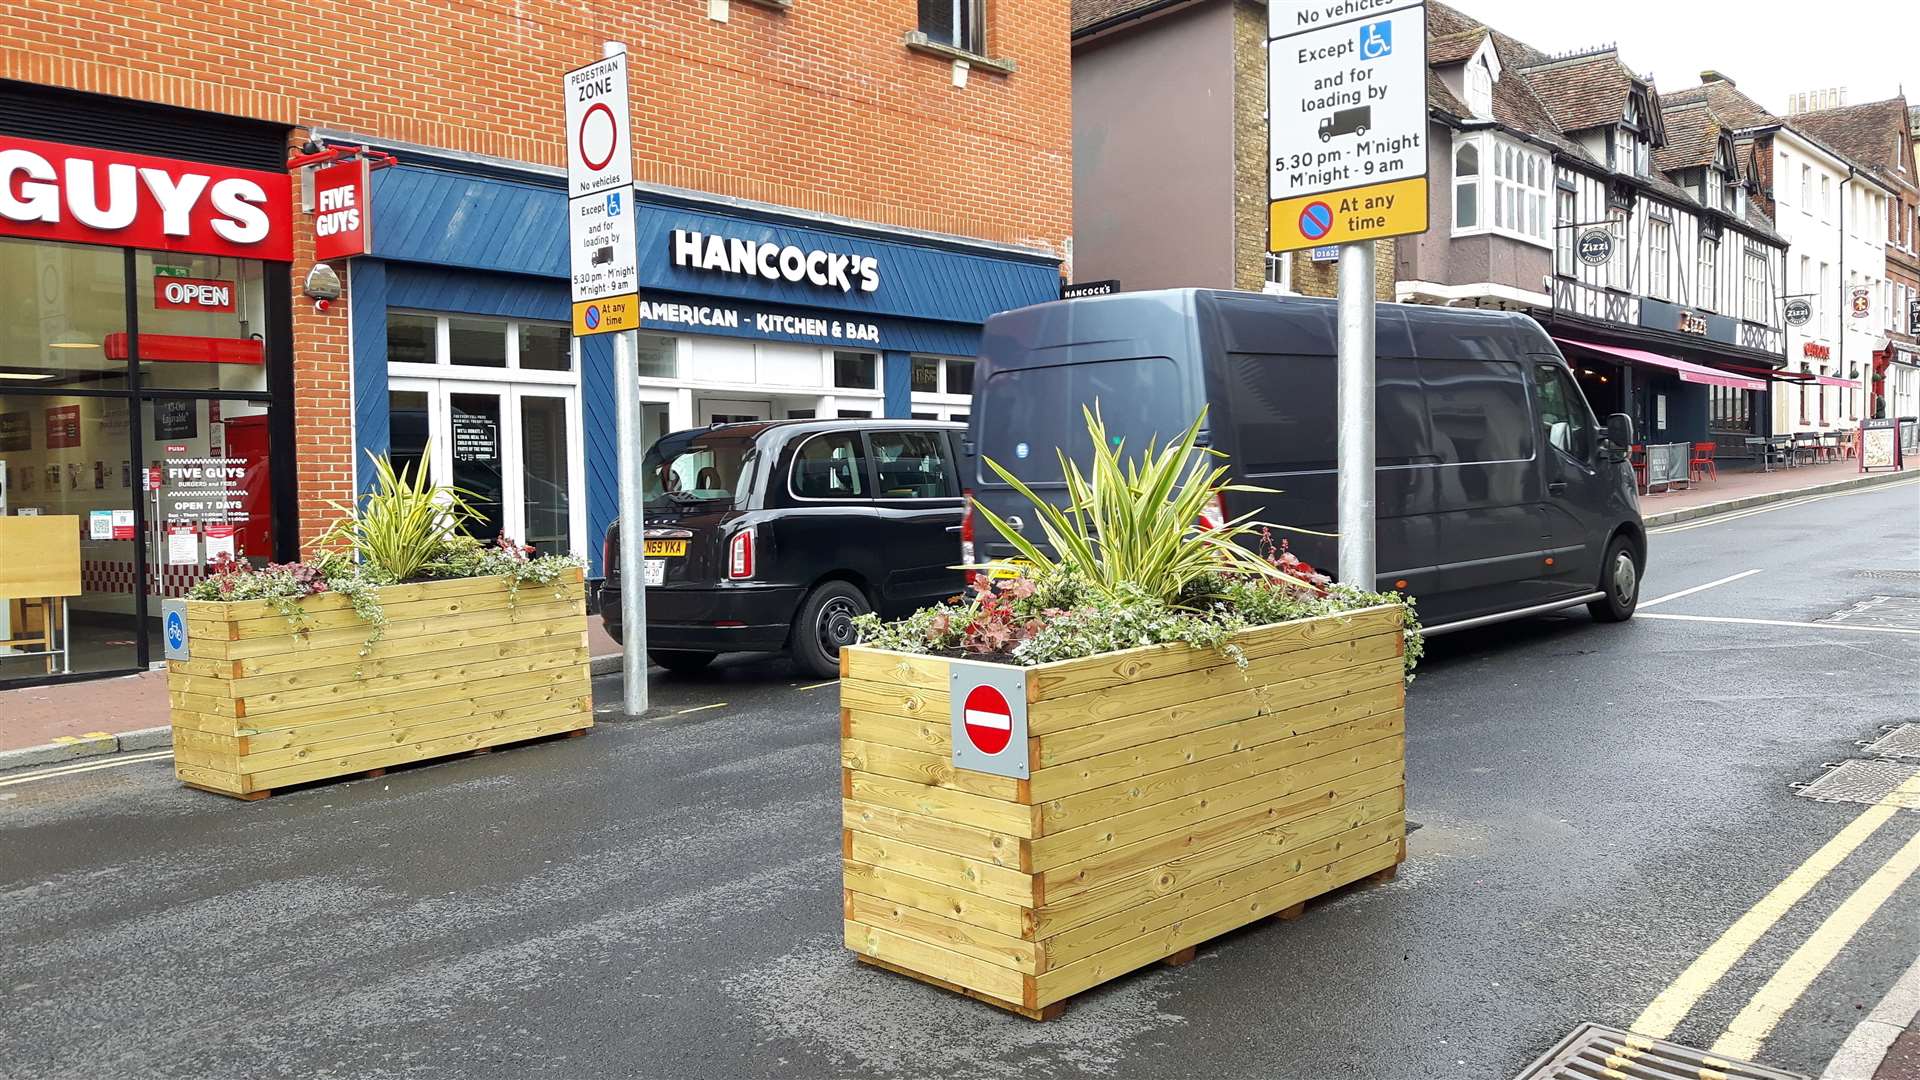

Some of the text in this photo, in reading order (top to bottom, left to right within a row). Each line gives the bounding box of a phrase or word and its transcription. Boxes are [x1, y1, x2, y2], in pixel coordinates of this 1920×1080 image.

[1297, 9, 1319, 25] No
[1298, 39, 1354, 64] Except
[571, 61, 618, 86] PEDESTRIAN
[1314, 68, 1373, 90] and for
[579, 77, 612, 102] ZONE
[1302, 84, 1387, 112] loading by
[1275, 153, 1312, 172] 5.30
[1317, 150, 1341, 167] pm
[1356, 133, 1420, 157] M'night
[1290, 166, 1349, 188] M'night
[1363, 160, 1374, 176] 9
[1379, 159, 1404, 173] am
[580, 174, 620, 191] No vehicles
[0, 148, 270, 244] GUYS
[320, 184, 355, 212] FIVE
[1340, 195, 1394, 213] At any
[581, 203, 605, 216] Except
[316, 208, 360, 237] GUYS
[588, 221, 614, 234] and for
[1348, 216, 1385, 231] time
[583, 233, 620, 248] loading by
[1582, 241, 1609, 252] Zizzi
[670, 228, 881, 293] HANCOCK'S
[573, 273, 590, 285] 5.30
[592, 273, 602, 284] pm
[611, 280, 616, 291] 9
[618, 280, 628, 290] am
[165, 282, 229, 306] OPEN
[1065, 284, 1110, 298] HANCOCK'S
[602, 303, 626, 314] At any
[606, 315, 622, 326] time
[640, 301, 738, 328] AMERICAN
[756, 312, 828, 337] KITCHEN
[831, 320, 842, 337] &
[846, 322, 880, 343] BAR
[169, 468, 202, 479] FIVE
[205, 467, 246, 478] GUYS
[175, 502, 204, 510] OPEN
[216, 501, 242, 509] DAYS
[644, 542, 681, 553] N69 VKA
